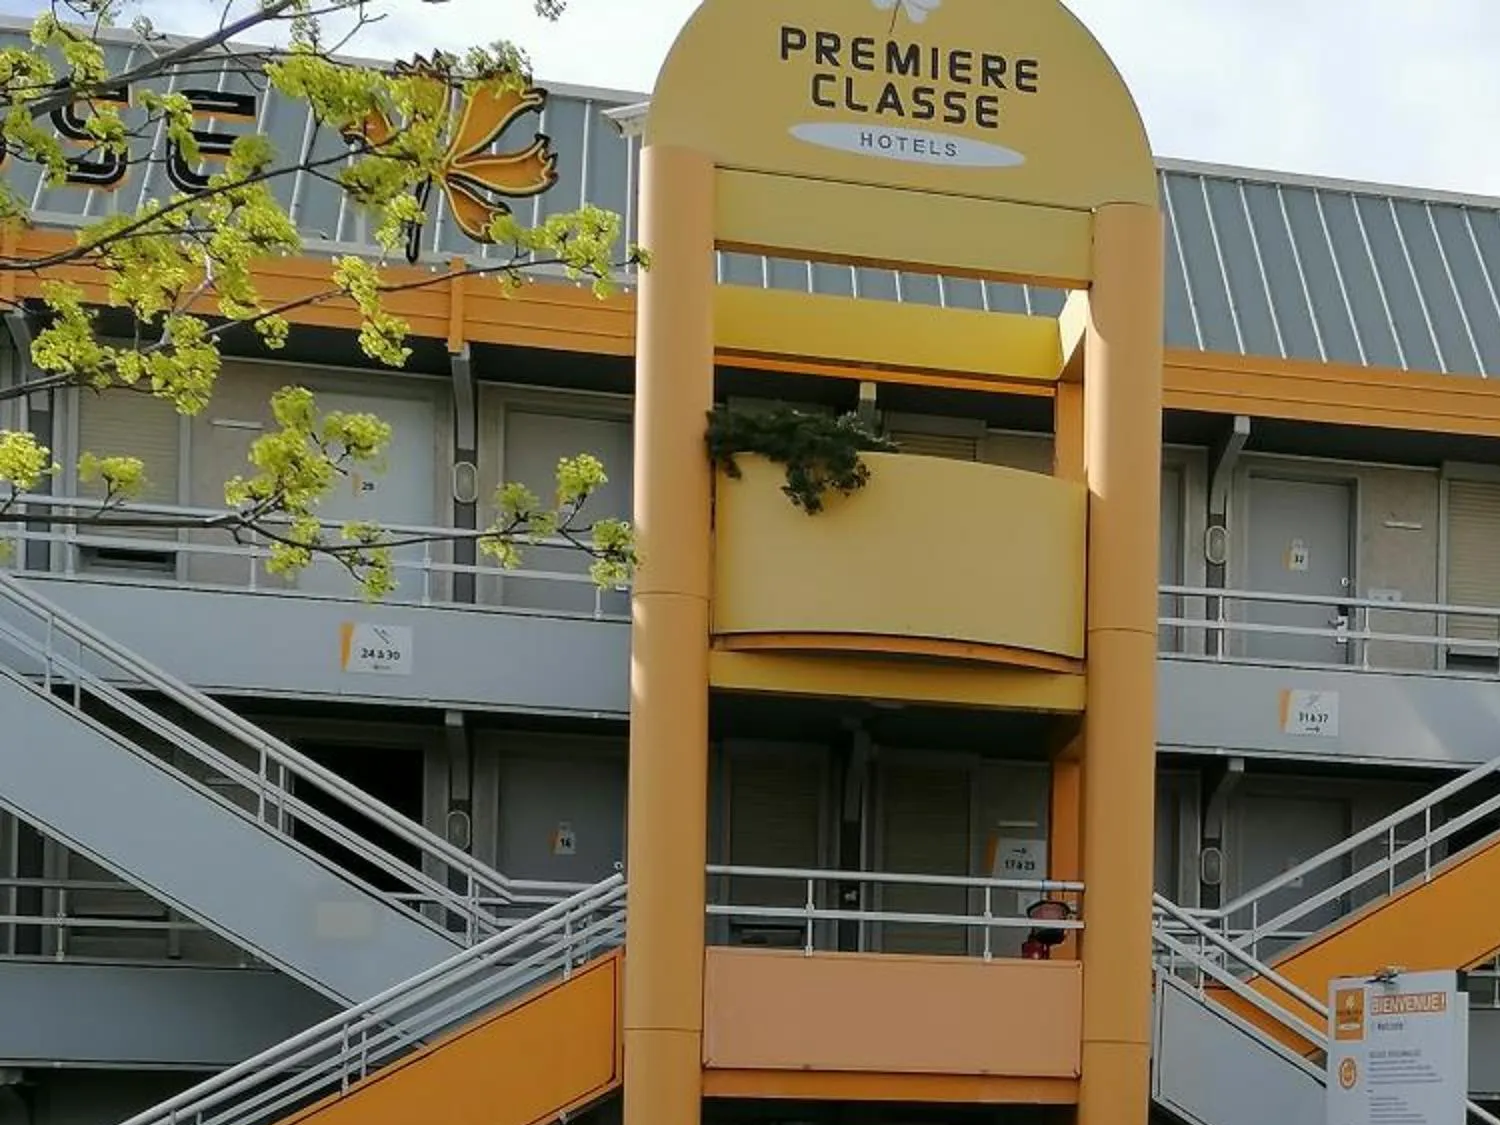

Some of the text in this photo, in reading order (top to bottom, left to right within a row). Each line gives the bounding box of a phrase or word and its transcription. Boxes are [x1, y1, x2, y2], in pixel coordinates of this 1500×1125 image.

[781, 26, 1039, 94] PREMIERE
[811, 73, 1000, 129] CLASSE
[860, 131, 959, 158] HOTELS
